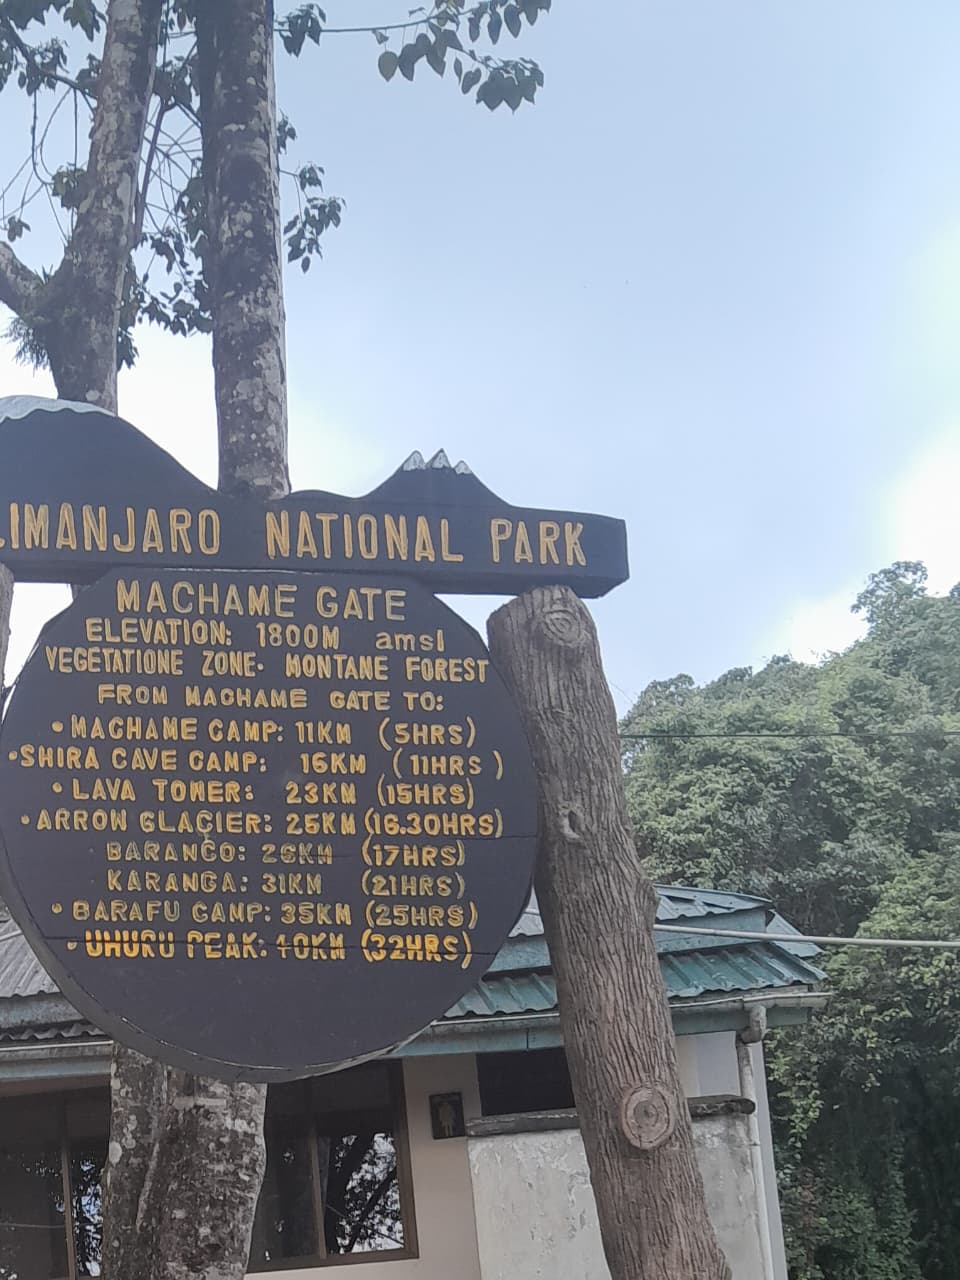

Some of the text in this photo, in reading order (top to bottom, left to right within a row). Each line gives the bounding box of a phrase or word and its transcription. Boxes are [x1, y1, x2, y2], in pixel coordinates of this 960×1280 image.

[265, 510, 464, 562] NATIONAL
[490, 518, 586, 566] PARK
[116, 579, 406, 621] MACHAME GATE
[85, 617, 445, 652] ELEVATION: 1800M amsl
[45, 645, 184, 676] VEGETATIONE
[285, 652, 388, 681] MONTANE
[405, 656, 489, 684] FOREST
[98, 683, 168, 706] FROM
[330, 690, 390, 712] GATE
[403, 691, 444, 712] TO:
[71, 714, 476, 752] MACHAME CAMP: 11KM (5HRS)
[20, 744, 100, 770] SHIRA
[111, 747, 177, 771] CAVE
[300, 752, 367, 775] 16KM
[72, 778, 136, 801] LAVA
[286, 781, 357, 804] 23KM
[377, 773, 474, 809] (15HRS)
[36, 807, 503, 838] ARROW GLACIER: 25KM (16.30HRS)
[262, 843, 333, 865] 26KM
[361, 835, 465, 866] (17HRS)
[107, 869, 465, 899] KARANGA: 31KM (21HRS)
[72, 899, 478, 929] BARAFU CAMP: 35KM (25HRS)
[85, 929, 176, 958] UHURU
[361, 928, 472, 969] (32HRS)
